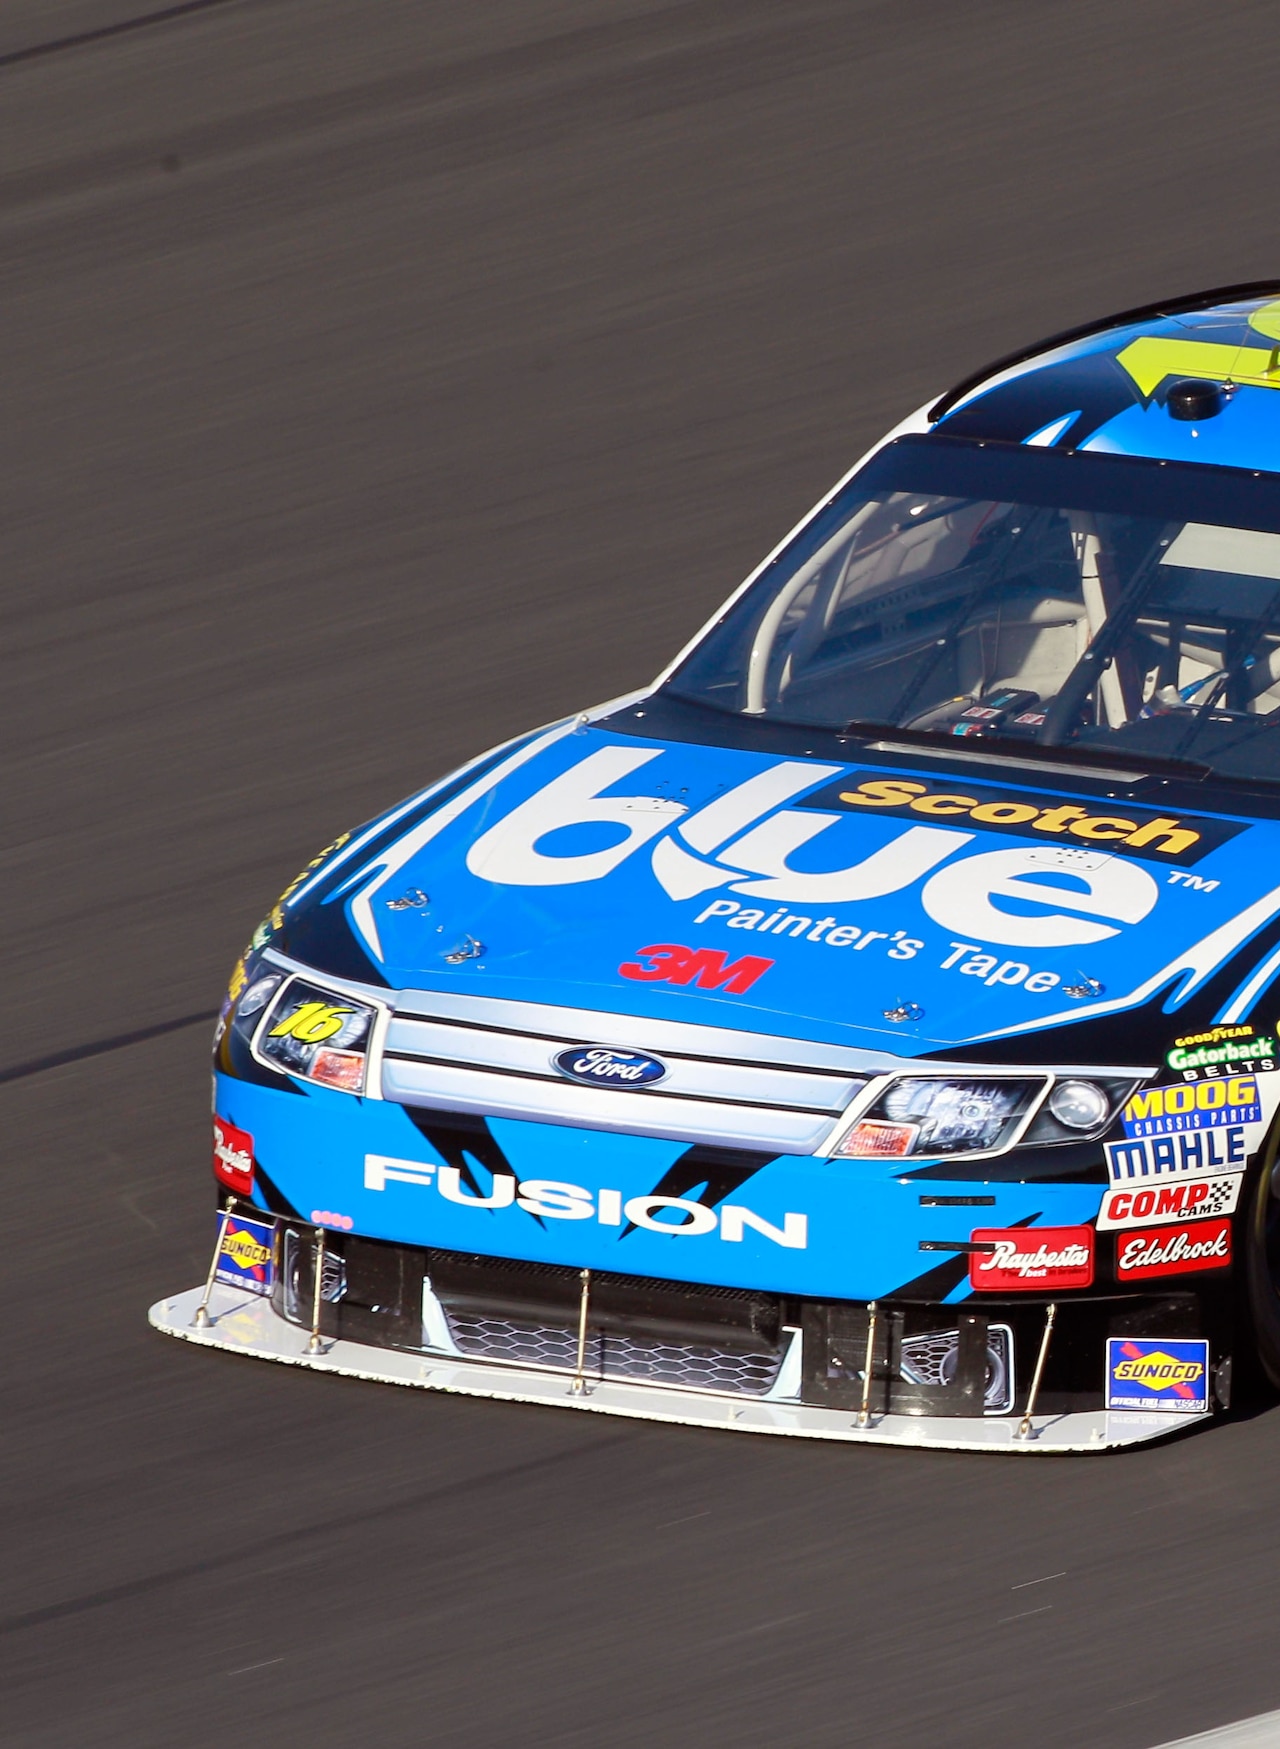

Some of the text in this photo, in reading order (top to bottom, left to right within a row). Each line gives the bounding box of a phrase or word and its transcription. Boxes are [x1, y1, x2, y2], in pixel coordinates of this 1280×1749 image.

[839, 779, 1200, 854] Scotch
[466, 746, 1159, 949] blue
[1168, 871, 1222, 893] TM
[693, 899, 1062, 994] Painter's Tape
[619, 944, 776, 994] 3M
[268, 1002, 356, 1044] 16
[1175, 1026, 1254, 1048] GOODYEAR
[573, 1048, 652, 1082] Ford
[1168, 1037, 1275, 1070] Gatorback
[1183, 1059, 1275, 1081] BELTS
[1125, 1076, 1256, 1122] MOOG
[1135, 1107, 1255, 1137] CHASSIS PARTS
[1109, 1126, 1245, 1180] MAHLE
[365, 1153, 808, 1250] FUSION
[1107, 1183, 1209, 1220] COMP
[1177, 1202, 1223, 1218] CAMS
[221, 1237, 267, 1262] SUNOCO
[979, 1241, 1090, 1277] Raybestos
[1119, 1228, 1229, 1270] Edelbrock
[1026, 1268, 1047, 1277] best
[1118, 1364, 1199, 1379] SUNOCO
